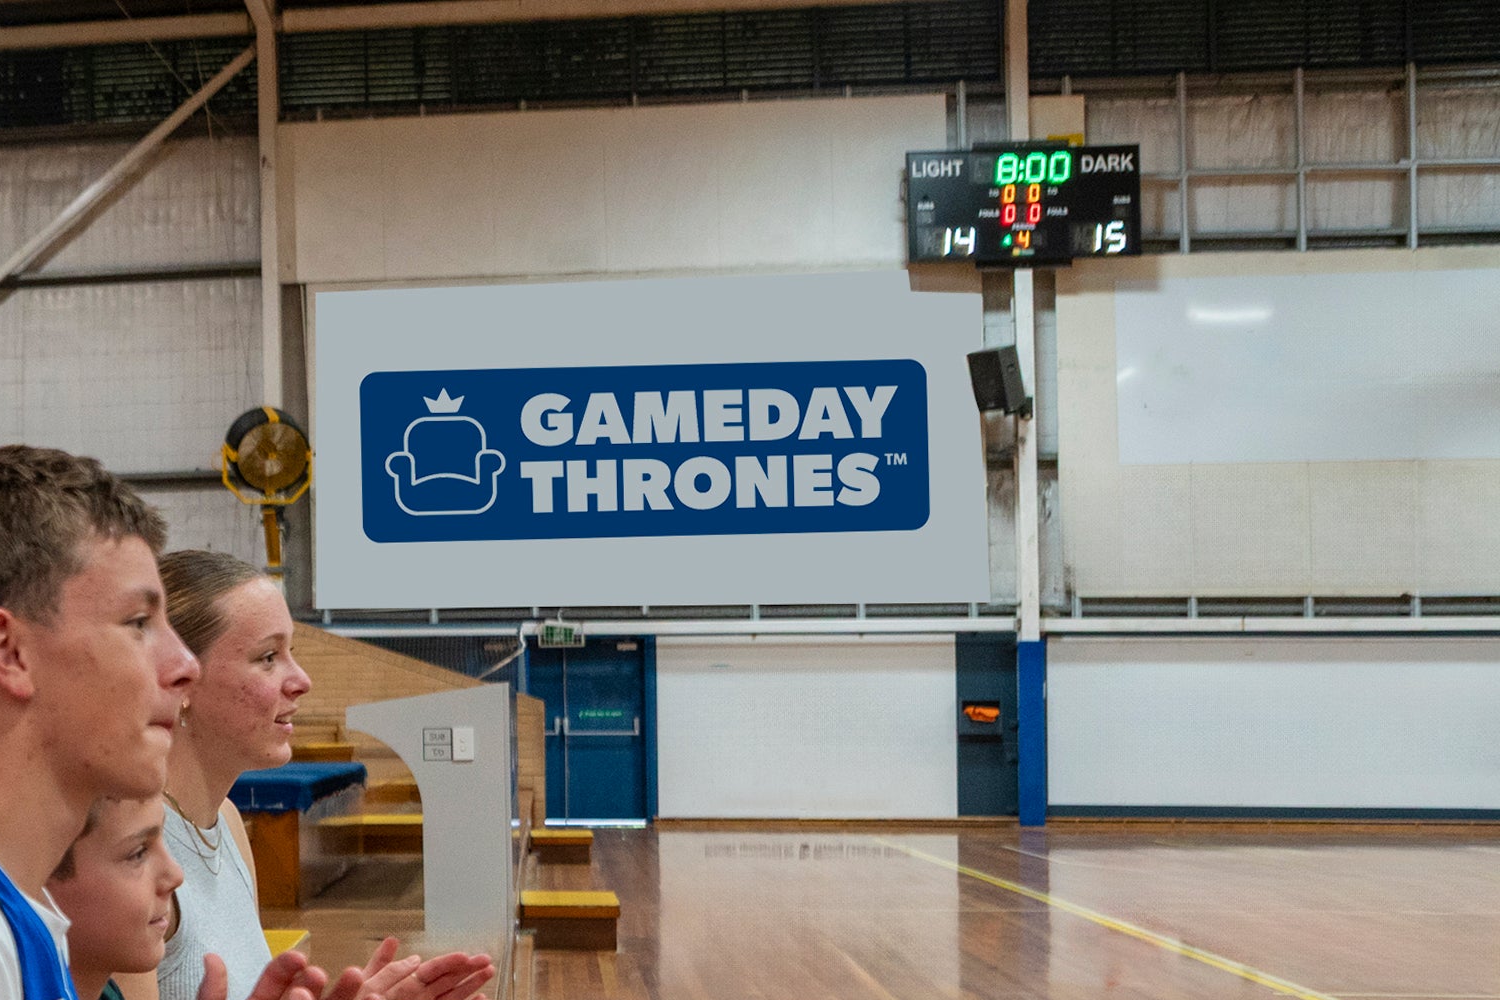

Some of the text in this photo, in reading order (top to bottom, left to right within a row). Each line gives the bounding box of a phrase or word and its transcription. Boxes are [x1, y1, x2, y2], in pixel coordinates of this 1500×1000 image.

[912, 159, 964, 178] LIGHT
[997, 151, 1072, 184] 8:00
[1081, 153, 1135, 174] DARK
[1003, 184, 1016, 203] 0
[1028, 183, 1041, 203] 0
[1003, 203, 1016, 225] 0
[1028, 203, 1041, 223] 0
[943, 226, 976, 256] 14
[1017, 230, 1030, 249] 4
[1093, 220, 1127, 253] 15
[520, 385, 899, 447] GAMEDAY
[520, 452, 881, 514] THRONES
